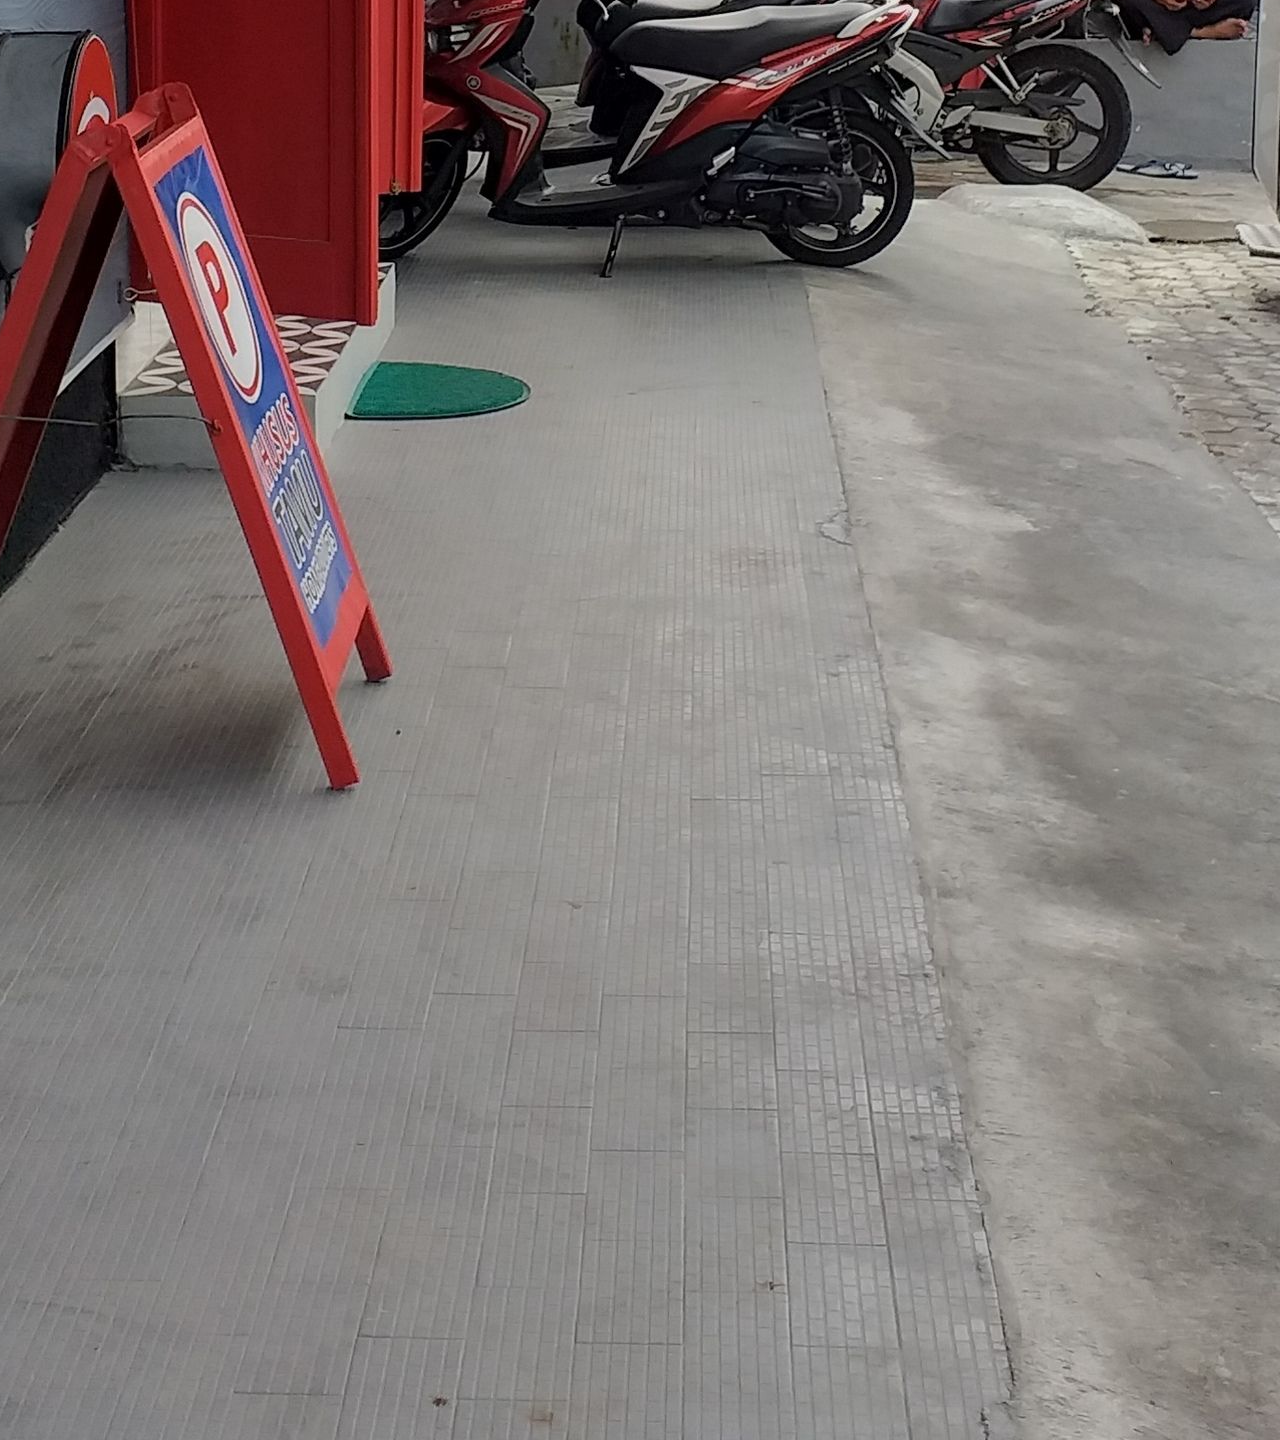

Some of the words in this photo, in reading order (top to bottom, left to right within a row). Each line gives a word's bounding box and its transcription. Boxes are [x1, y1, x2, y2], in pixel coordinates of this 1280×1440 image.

[194, 241, 237, 357] P
[272, 449, 324, 570] TAMU
[299, 520, 339, 615] HOMETS
